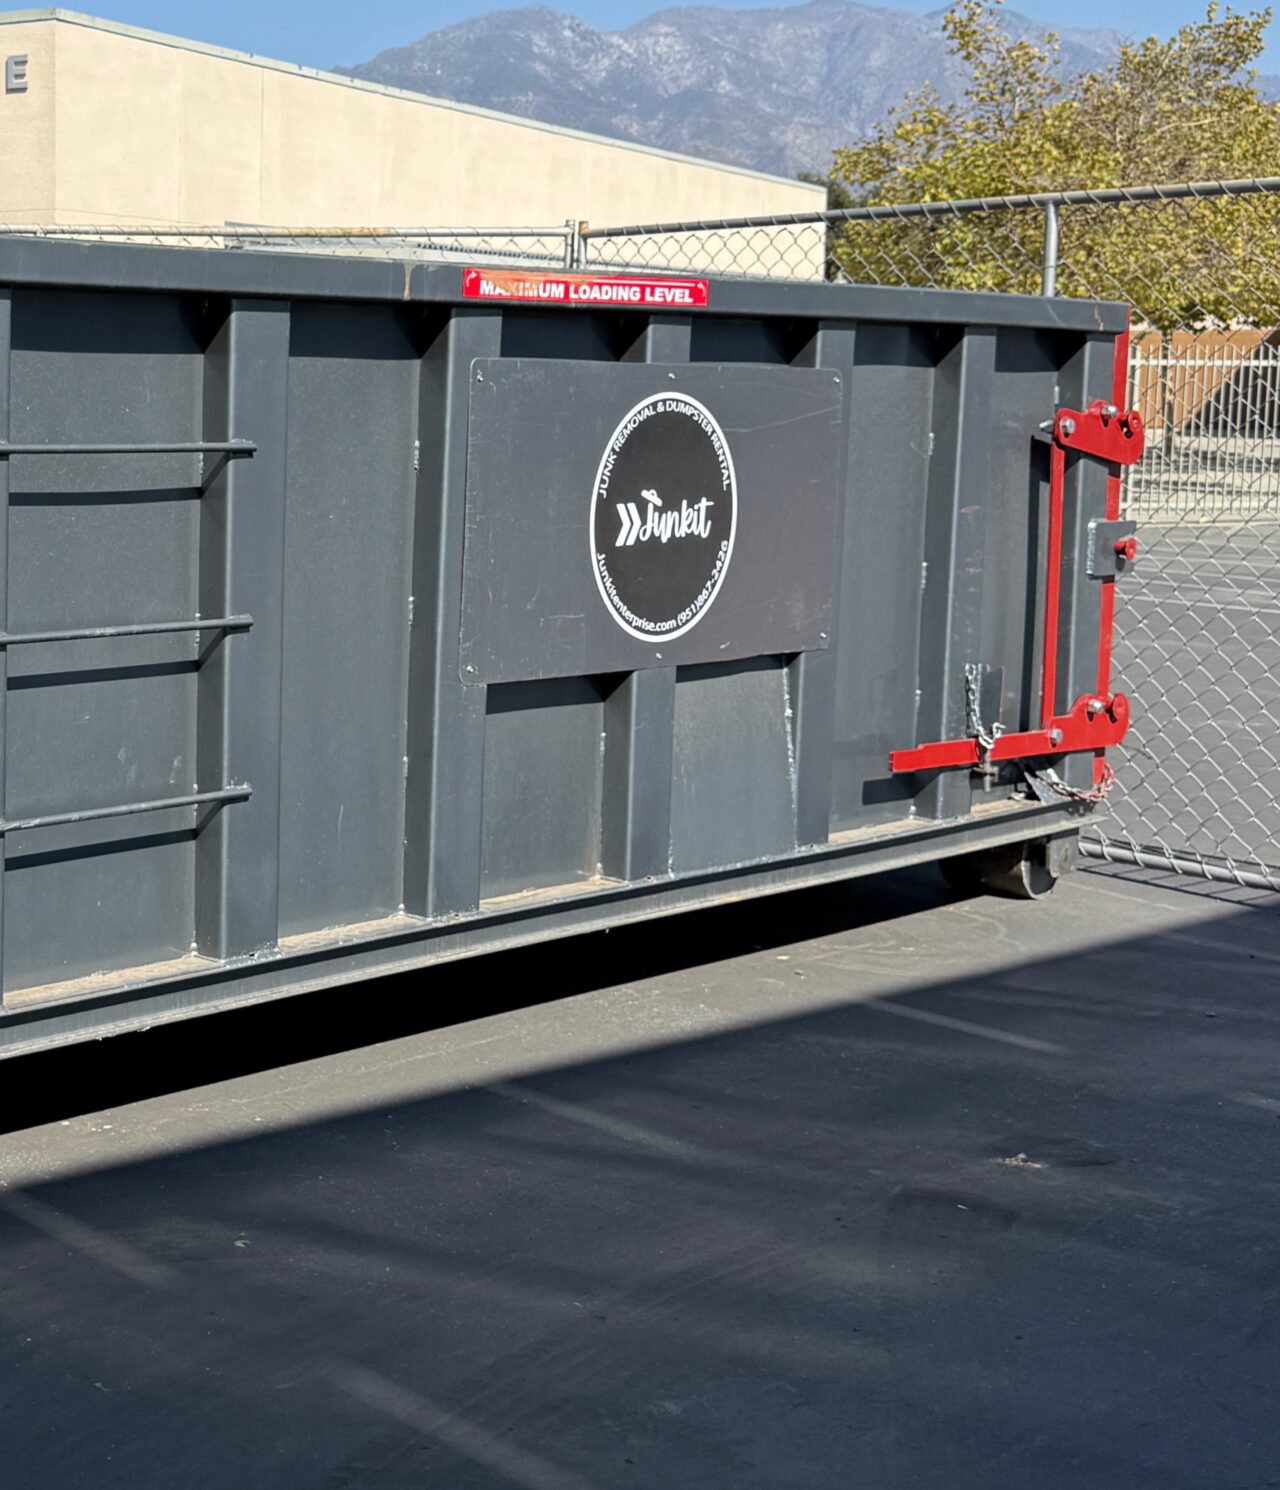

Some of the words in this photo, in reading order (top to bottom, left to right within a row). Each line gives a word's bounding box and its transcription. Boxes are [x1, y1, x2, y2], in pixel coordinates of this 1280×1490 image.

[5, 54, 28, 95] E
[480, 280, 565, 298] MAXIMUM
[569, 283, 641, 301] LOADING
[644, 287, 694, 303] LEVEL
[598, 452, 618, 499] JUNK
[613, 404, 657, 452] REMOVAL
[656, 401, 665, 413] &
[666, 400, 713, 437] DUMPSTER
[710, 432, 732, 492] RENTAL
[639, 489, 714, 543] Junkit
[596, 552, 677, 632] Junkitenterprise.com
[677, 539, 729, 626] (951)867-2426
